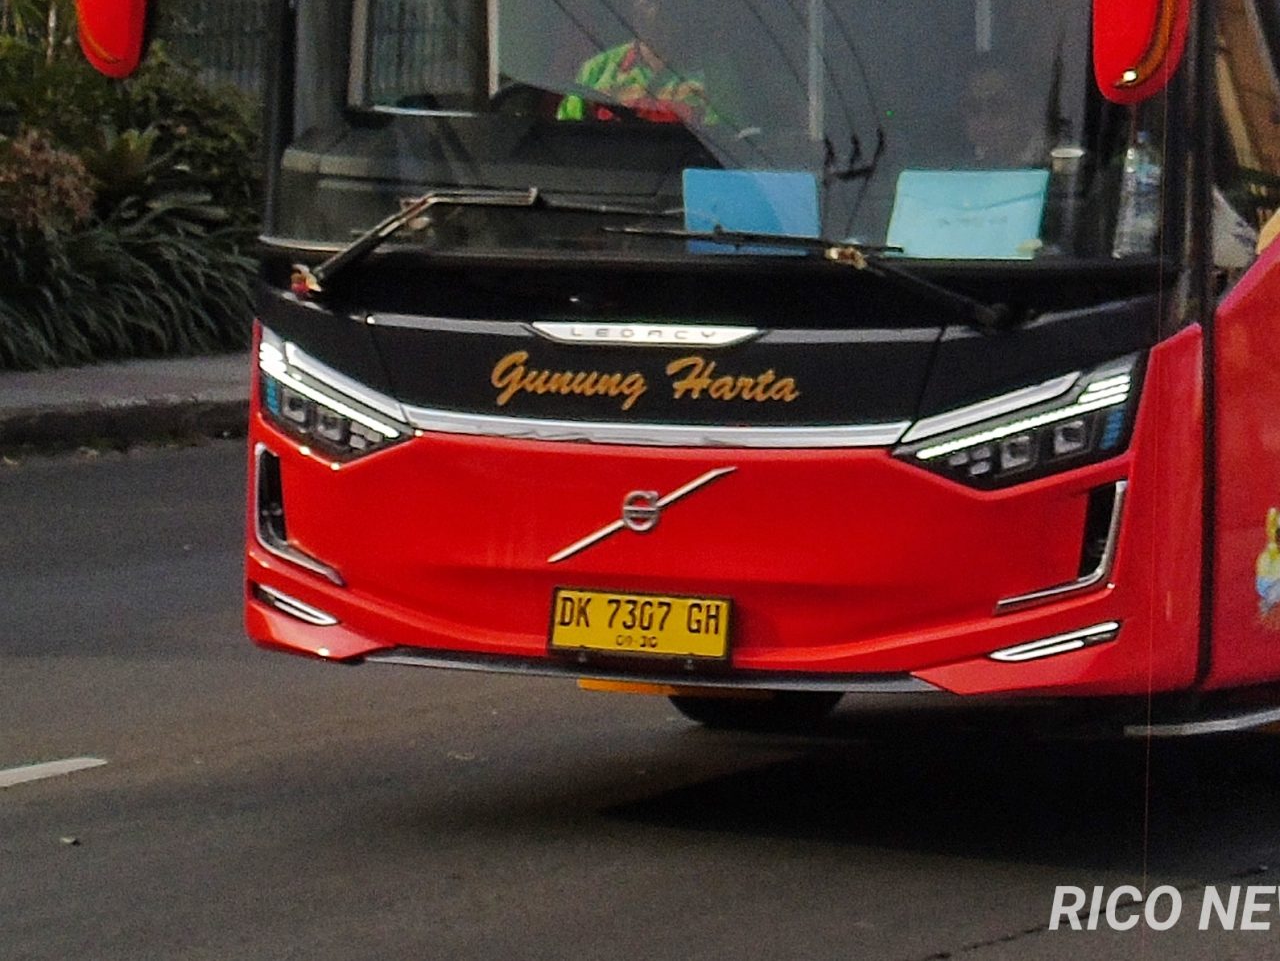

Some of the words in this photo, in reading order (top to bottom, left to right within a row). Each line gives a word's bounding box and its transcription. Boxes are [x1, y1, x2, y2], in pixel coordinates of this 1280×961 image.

[570, 326, 716, 339] LEGACY
[491, 351, 648, 411] Gunung
[666, 356, 799, 403] Harta
[559, 596, 592, 628] DK
[607, 599, 672, 632] 7307
[687, 603, 721, 635] GH
